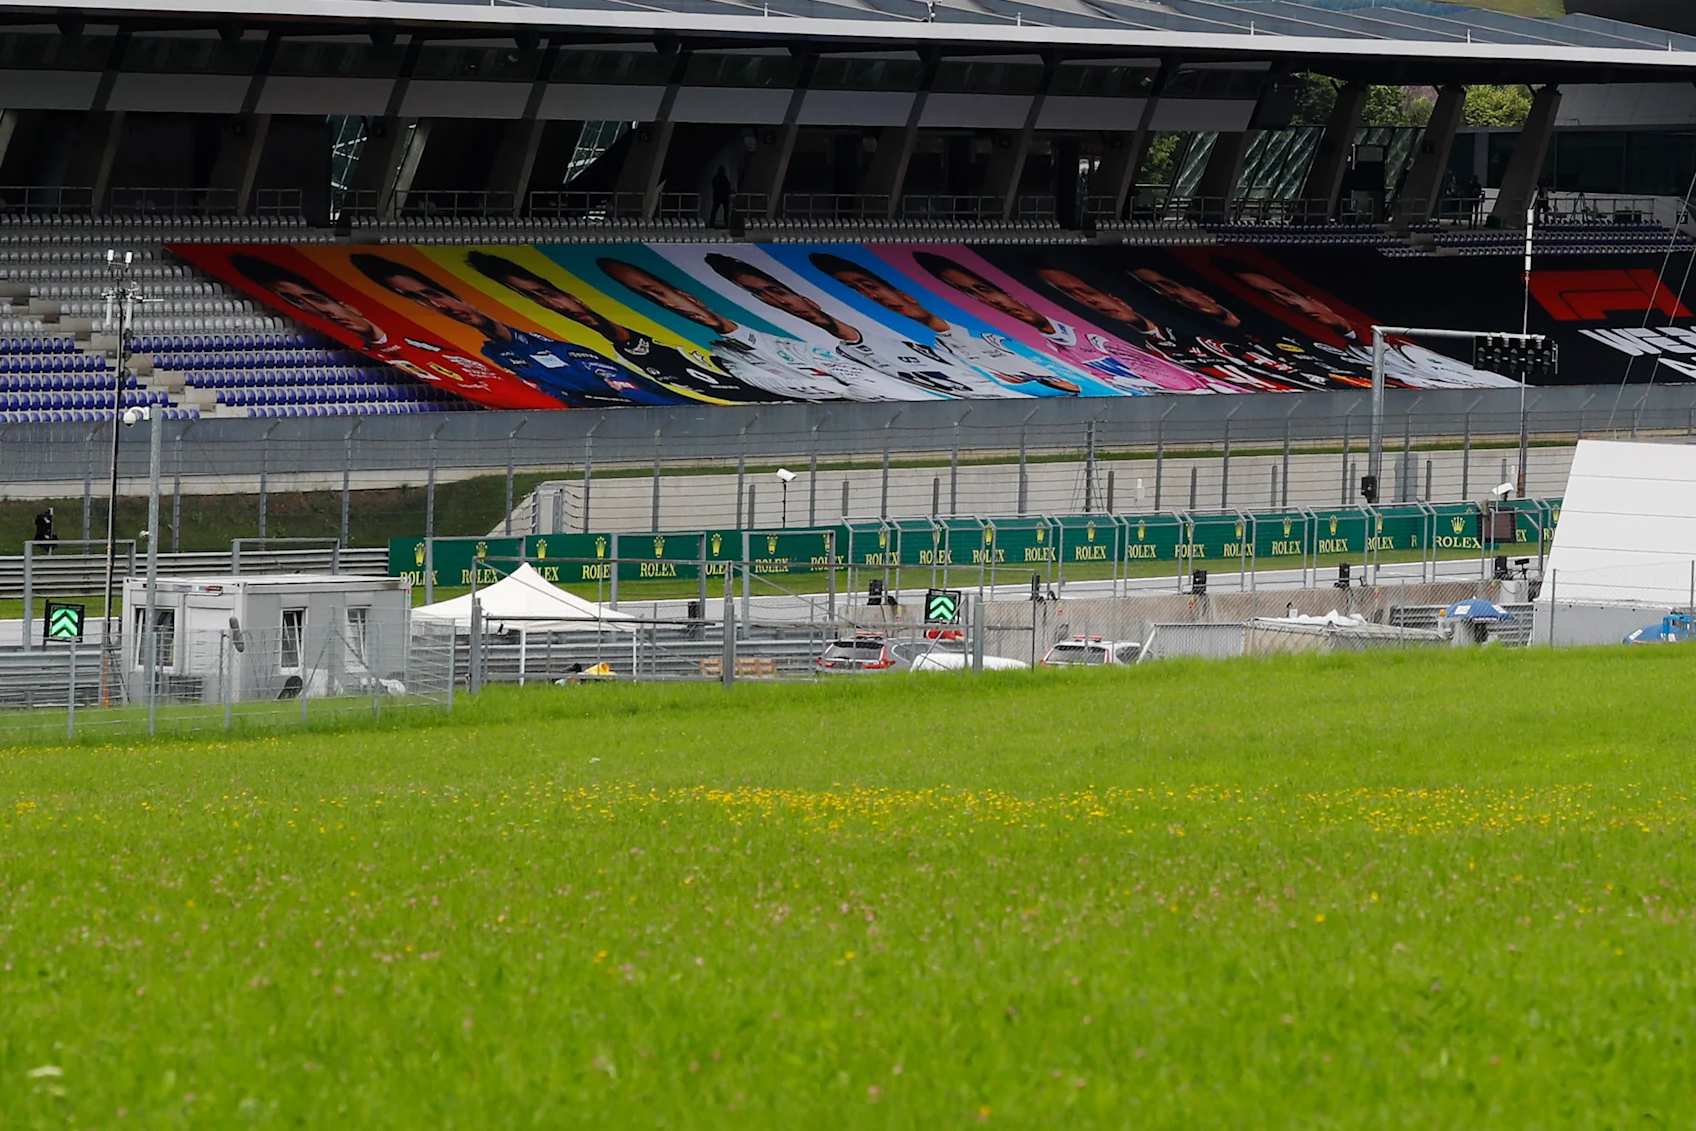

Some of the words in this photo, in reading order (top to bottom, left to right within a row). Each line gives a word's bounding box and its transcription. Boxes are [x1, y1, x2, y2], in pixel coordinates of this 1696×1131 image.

[1272, 541, 1301, 555] ROLEX
[1319, 538, 1348, 552] ROLEX
[1436, 536, 1482, 549] ROLEX
[919, 549, 952, 564] ROEX
[1075, 546, 1107, 560] ROLEX
[1128, 544, 1156, 559] ROLEX
[640, 563, 677, 577] ROLEX
[704, 562, 726, 576] OLE
[755, 558, 789, 573] ROLEX
[810, 555, 845, 571] ROLX
[582, 564, 612, 580] ROLE
